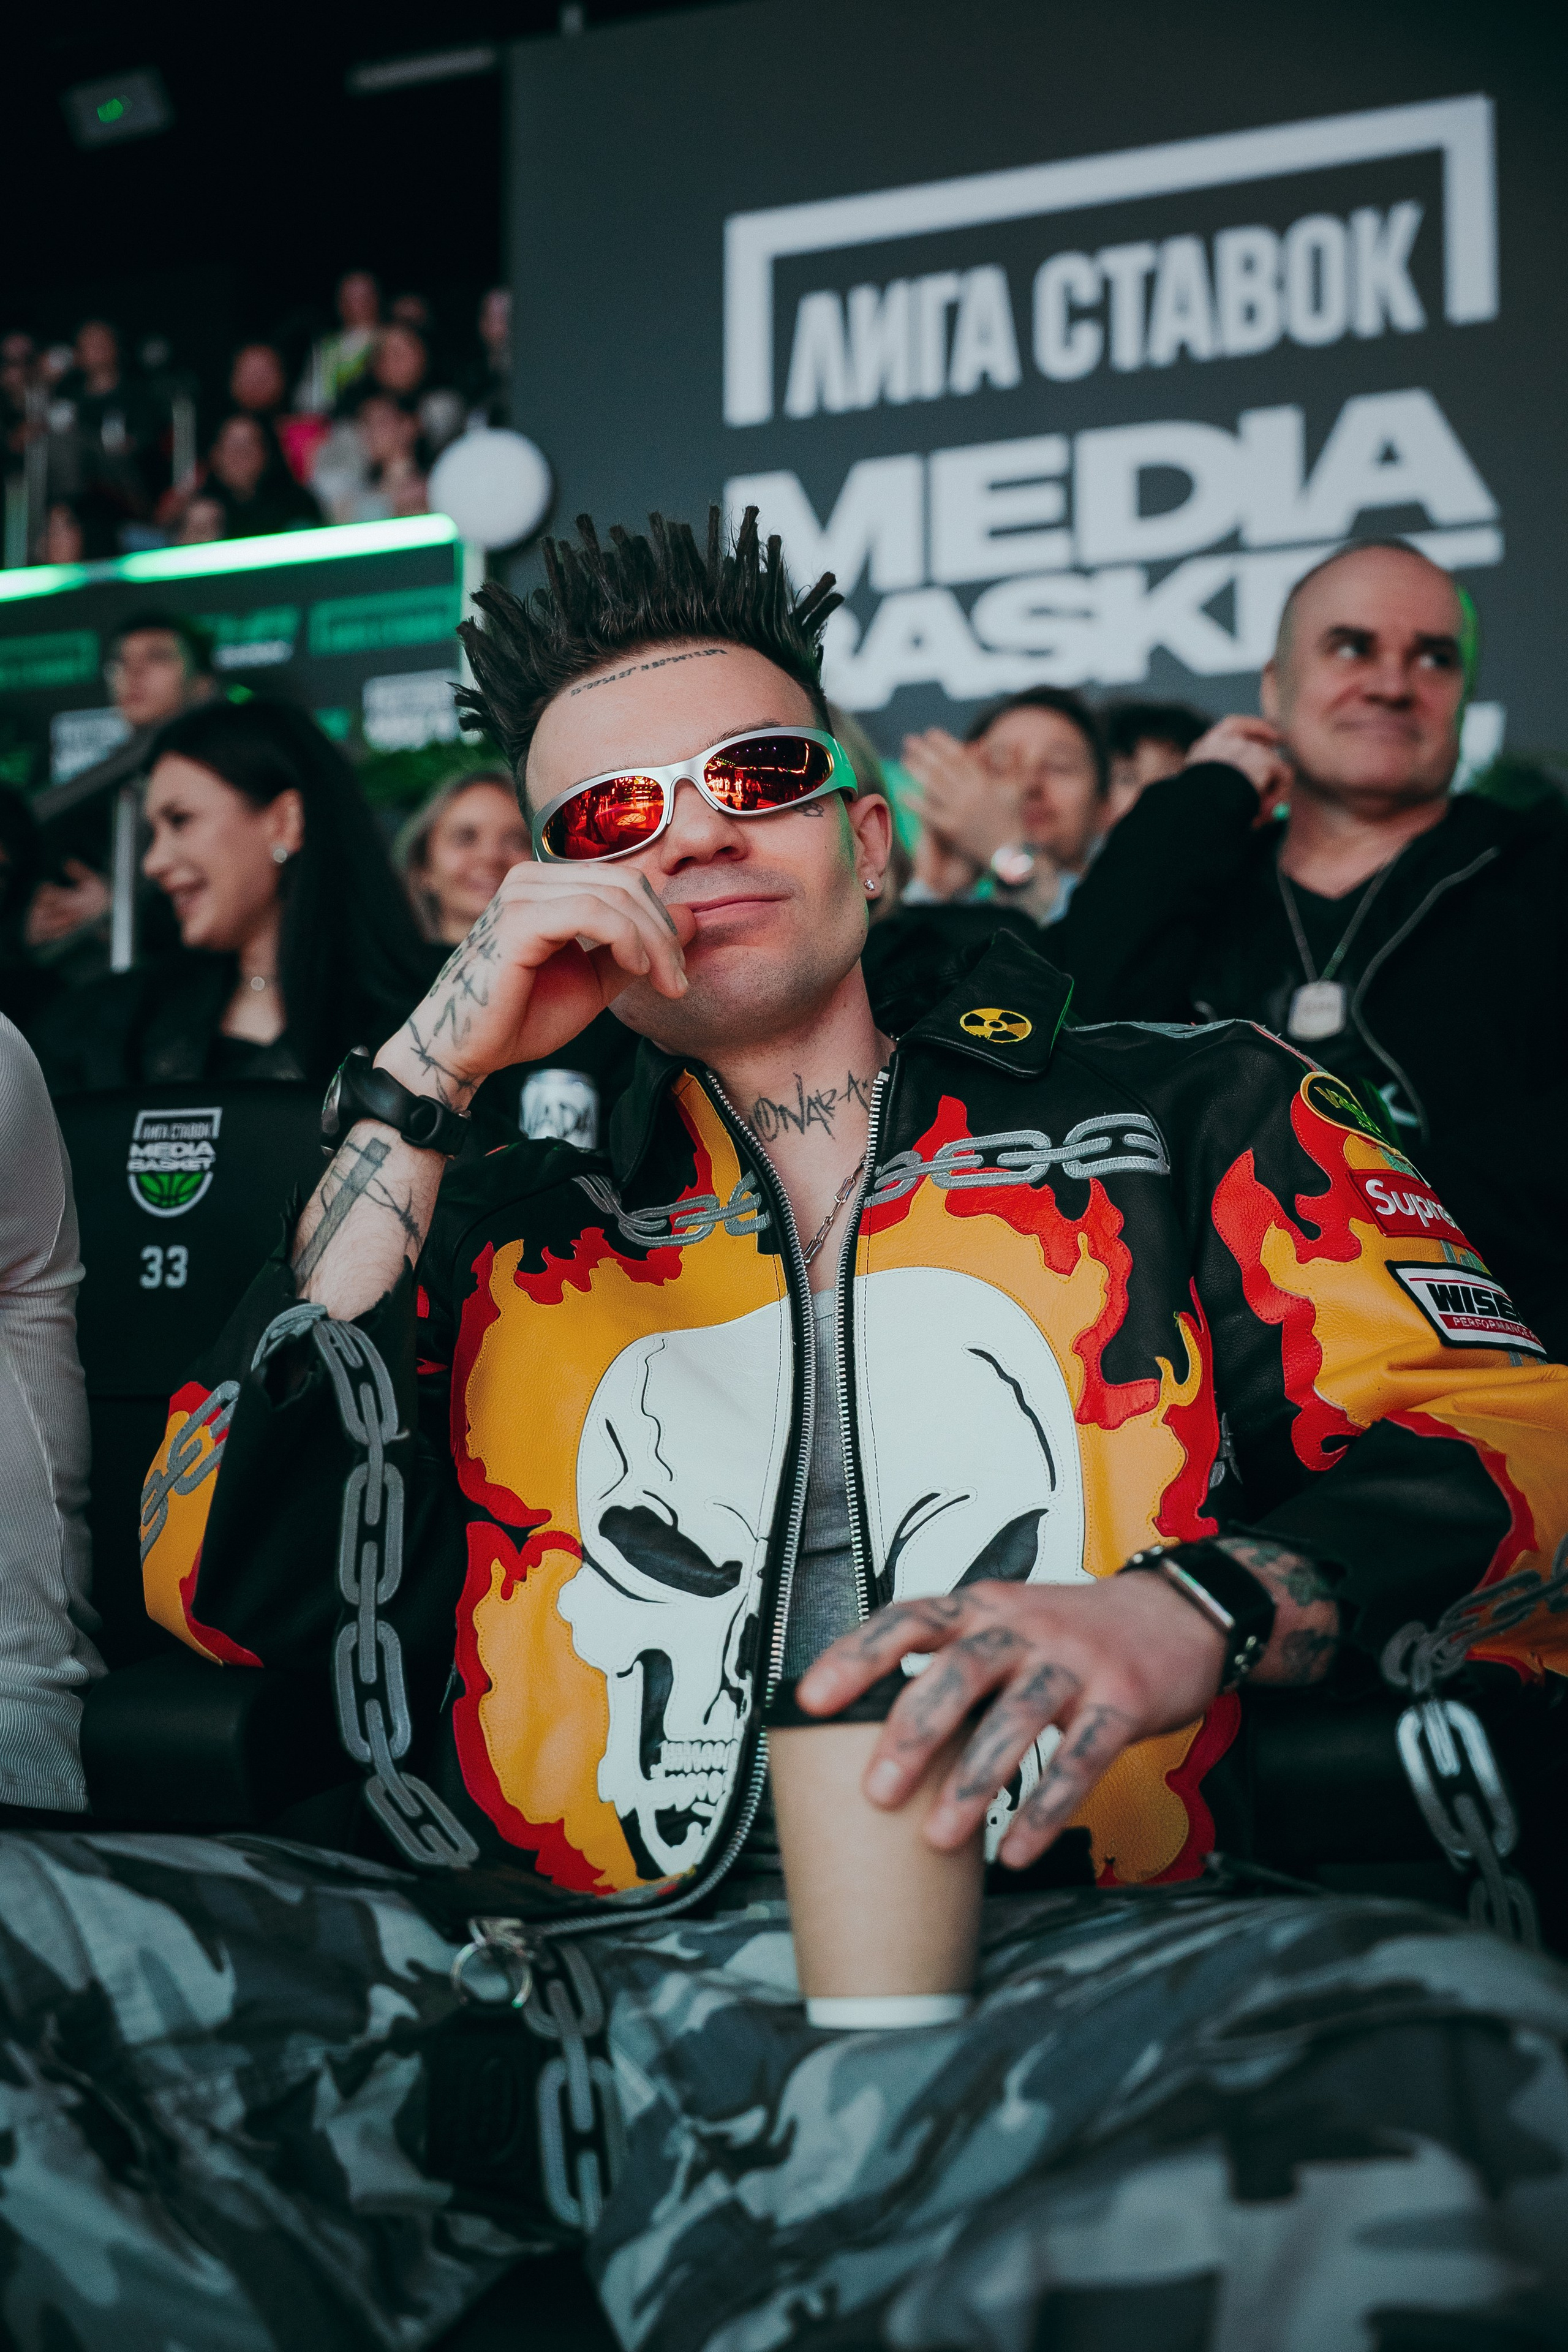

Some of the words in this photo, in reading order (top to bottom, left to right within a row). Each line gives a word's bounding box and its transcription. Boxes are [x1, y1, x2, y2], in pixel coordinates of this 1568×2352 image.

[784, 263, 1021, 419] ЛИГА
[1033, 200, 1424, 381] СТАВОК
[723, 387, 1501, 597] MEDIA
[129, 1140, 216, 1158] MEDIA
[1365, 1178, 1459, 1231] Supre
[140, 1245, 188, 1289] 33
[1426, 1283, 1523, 1325] WISE
[1453, 1316, 1530, 1338] PERFORMANCE
